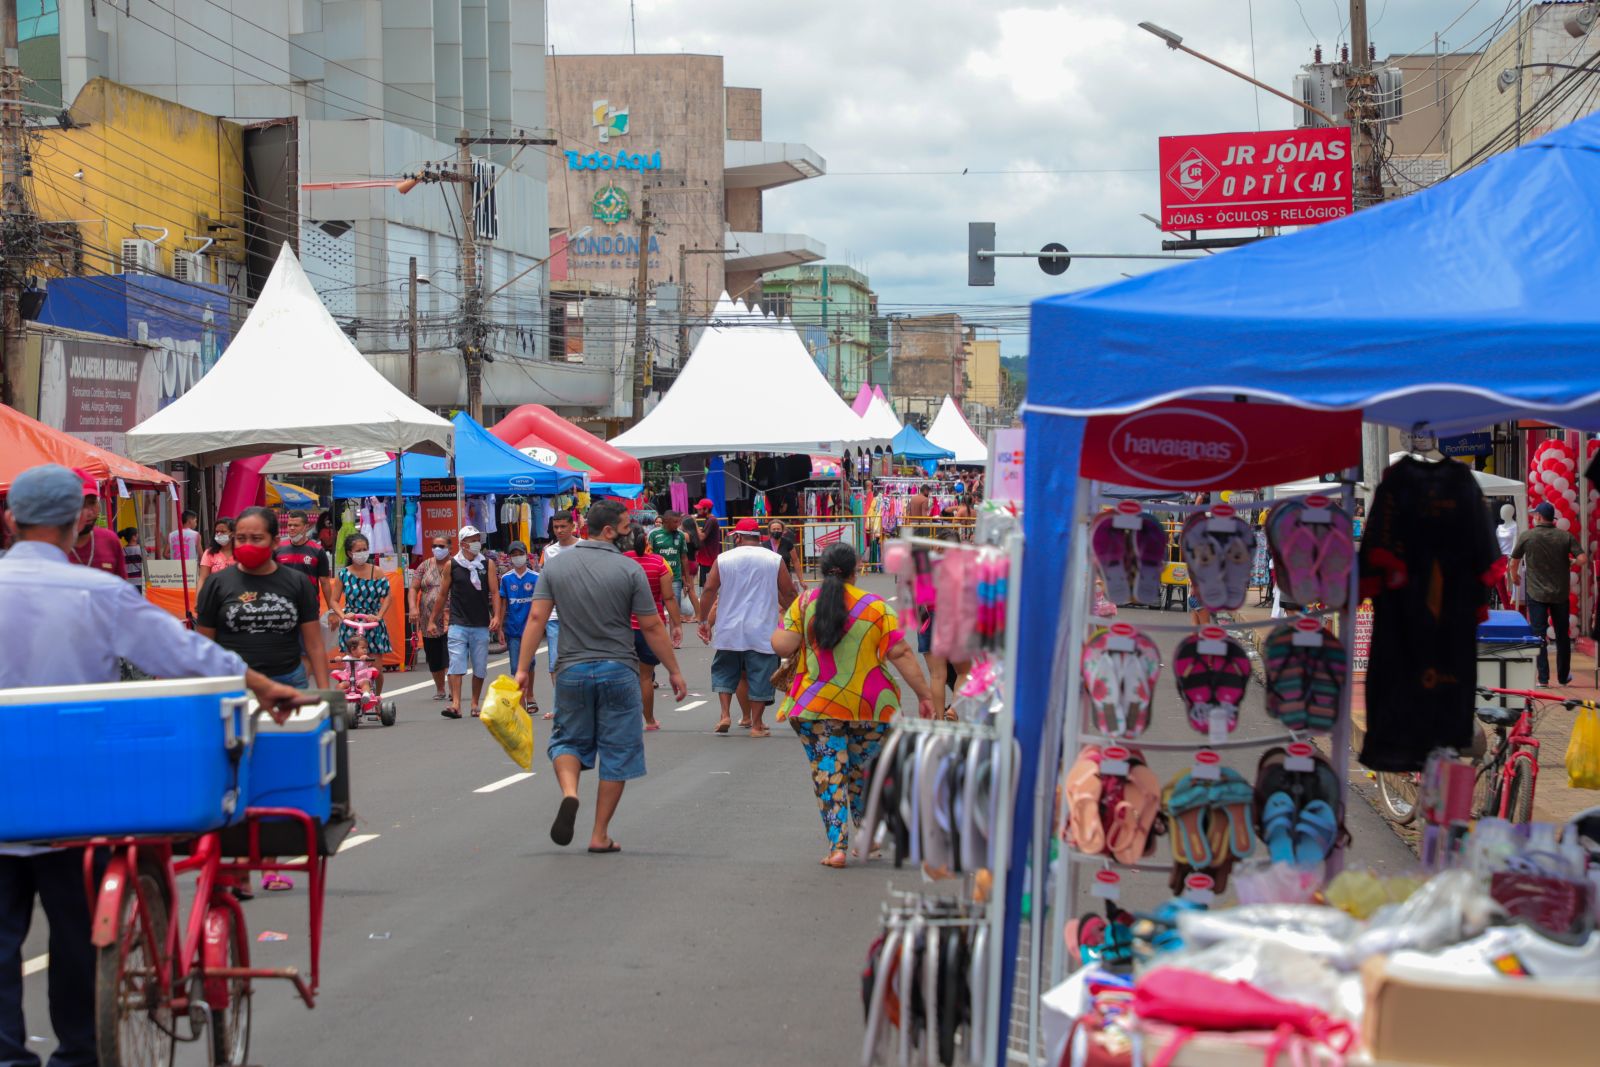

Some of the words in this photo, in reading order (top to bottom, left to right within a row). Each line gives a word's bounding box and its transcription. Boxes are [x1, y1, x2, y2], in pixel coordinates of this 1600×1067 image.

[563, 149, 612, 171] Tudo
[614, 148, 662, 174] Aqui
[1221, 145, 1256, 166] JR
[1262, 137, 1346, 164] JÓIAS
[1276, 164, 1285, 174] &
[1222, 171, 1344, 197] OPTICAS
[1167, 212, 1205, 225] JÓIAS
[1216, 210, 1269, 223] ÓCULOS
[1280, 205, 1347, 220] RELÓGIOS
[70, 355, 104, 380] JOALHERIA
[105, 358, 138, 382] BRILHANTE
[1124, 431, 1231, 460] havaianas
